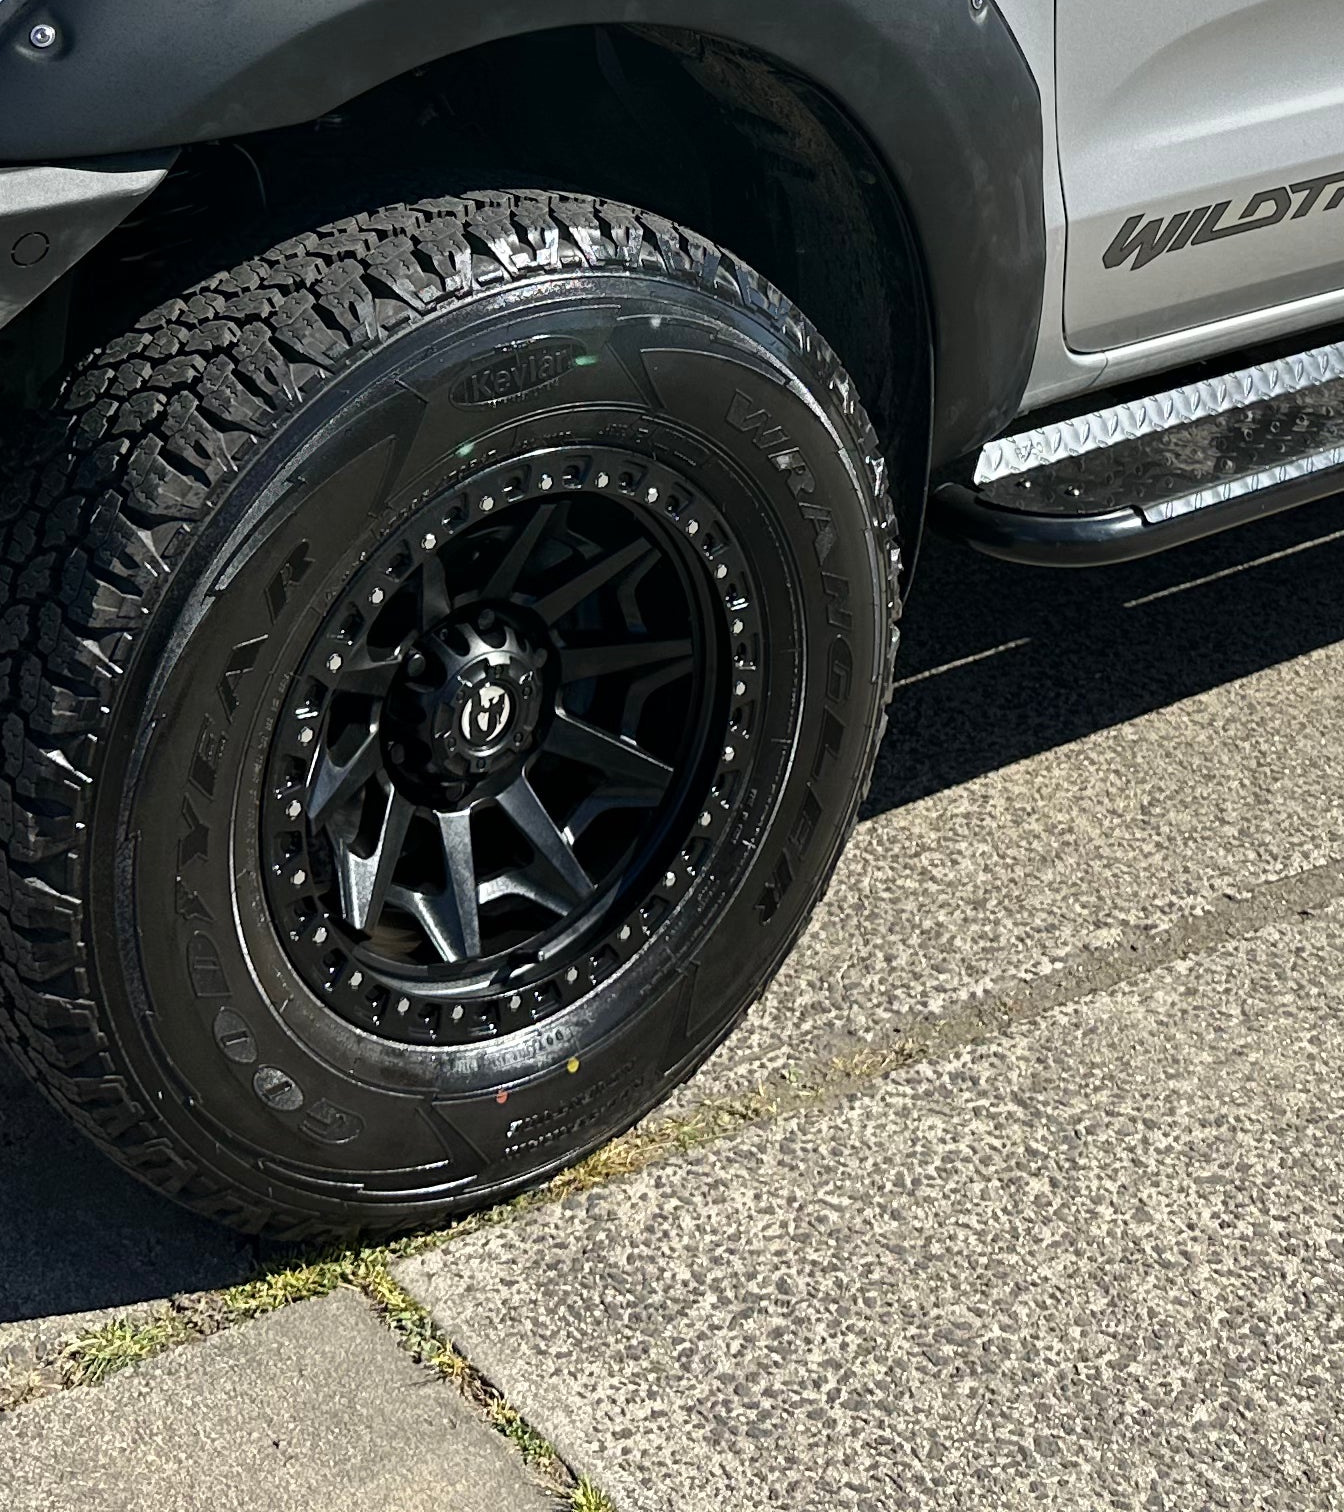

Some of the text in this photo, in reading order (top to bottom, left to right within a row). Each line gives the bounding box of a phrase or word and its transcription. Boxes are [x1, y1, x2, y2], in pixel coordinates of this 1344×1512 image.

[471, 348, 571, 402] Kevlar
[177, 538, 365, 1145] GOODYEAR
[724, 388, 854, 926] WRANGLER
